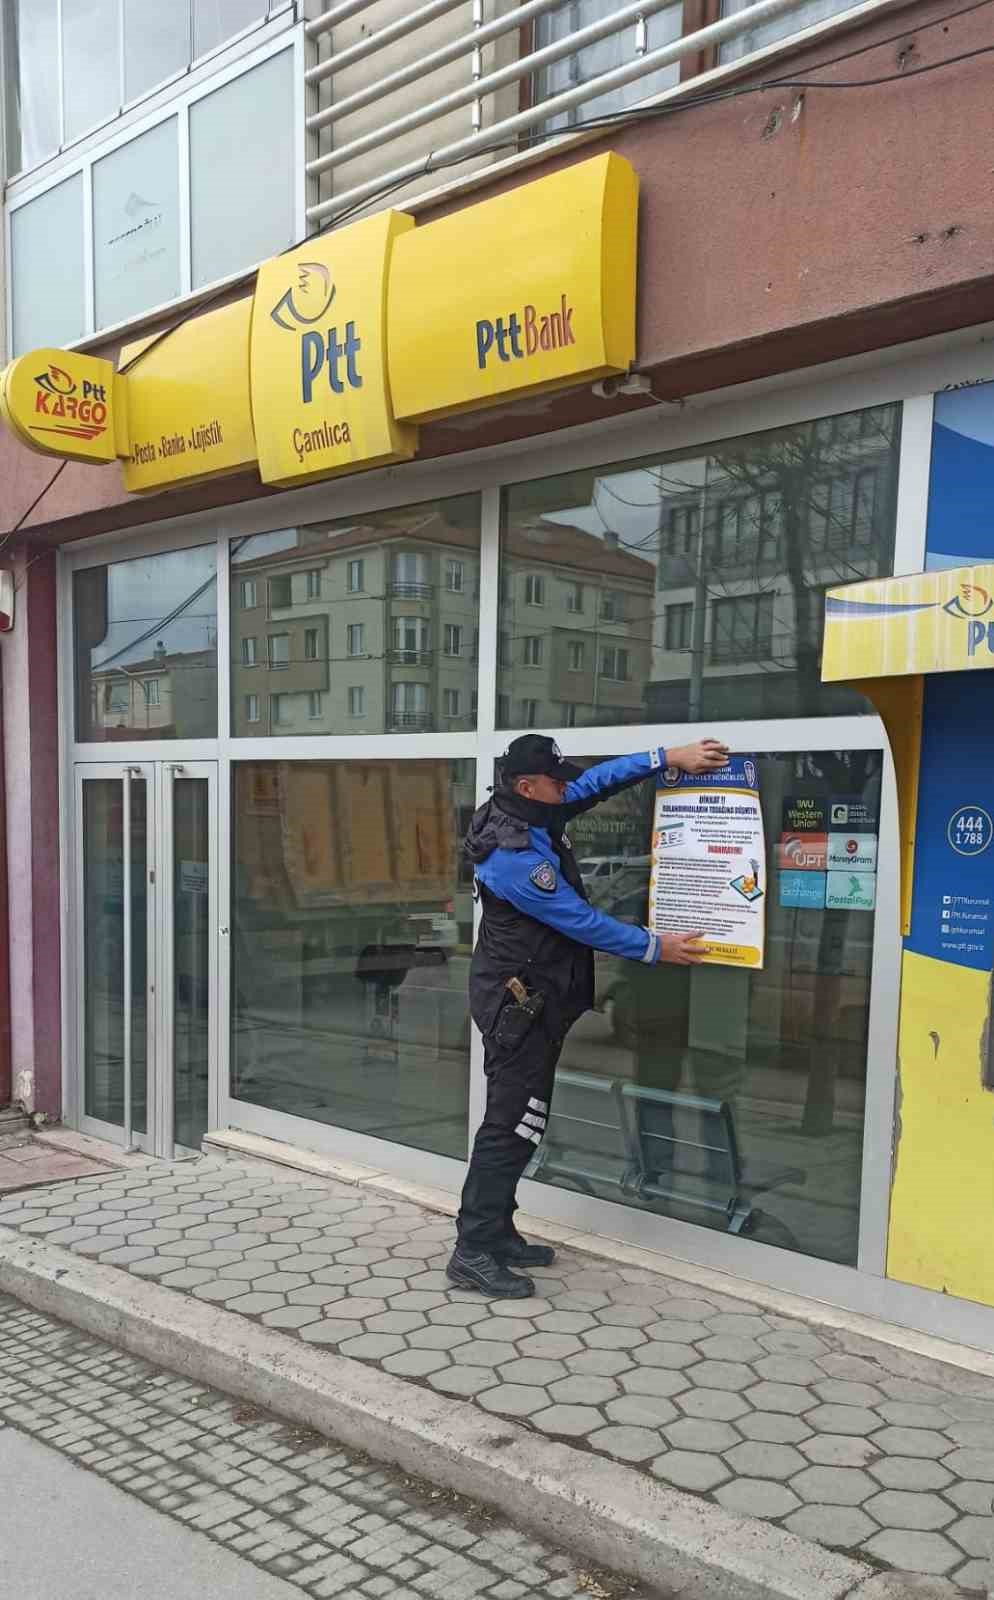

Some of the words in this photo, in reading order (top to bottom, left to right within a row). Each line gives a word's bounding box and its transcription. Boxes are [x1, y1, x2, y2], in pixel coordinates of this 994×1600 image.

[301, 320, 362, 403] Ptt
[82, 380, 106, 402] Ptt
[35, 390, 107, 425] KARGO
[134, 442, 156, 464] Posta
[162, 433, 186, 457] Banka
[191, 420, 224, 452] Lojistik
[293, 421, 351, 462] Çamlıca
[788, 810, 823, 819] Western
[793, 819, 817, 828] Union
[956, 816, 984, 832] 444
[796, 854, 824, 867] UPT
[829, 855, 872, 864] MoneyGram
[828, 895, 873, 906] PostalPay
